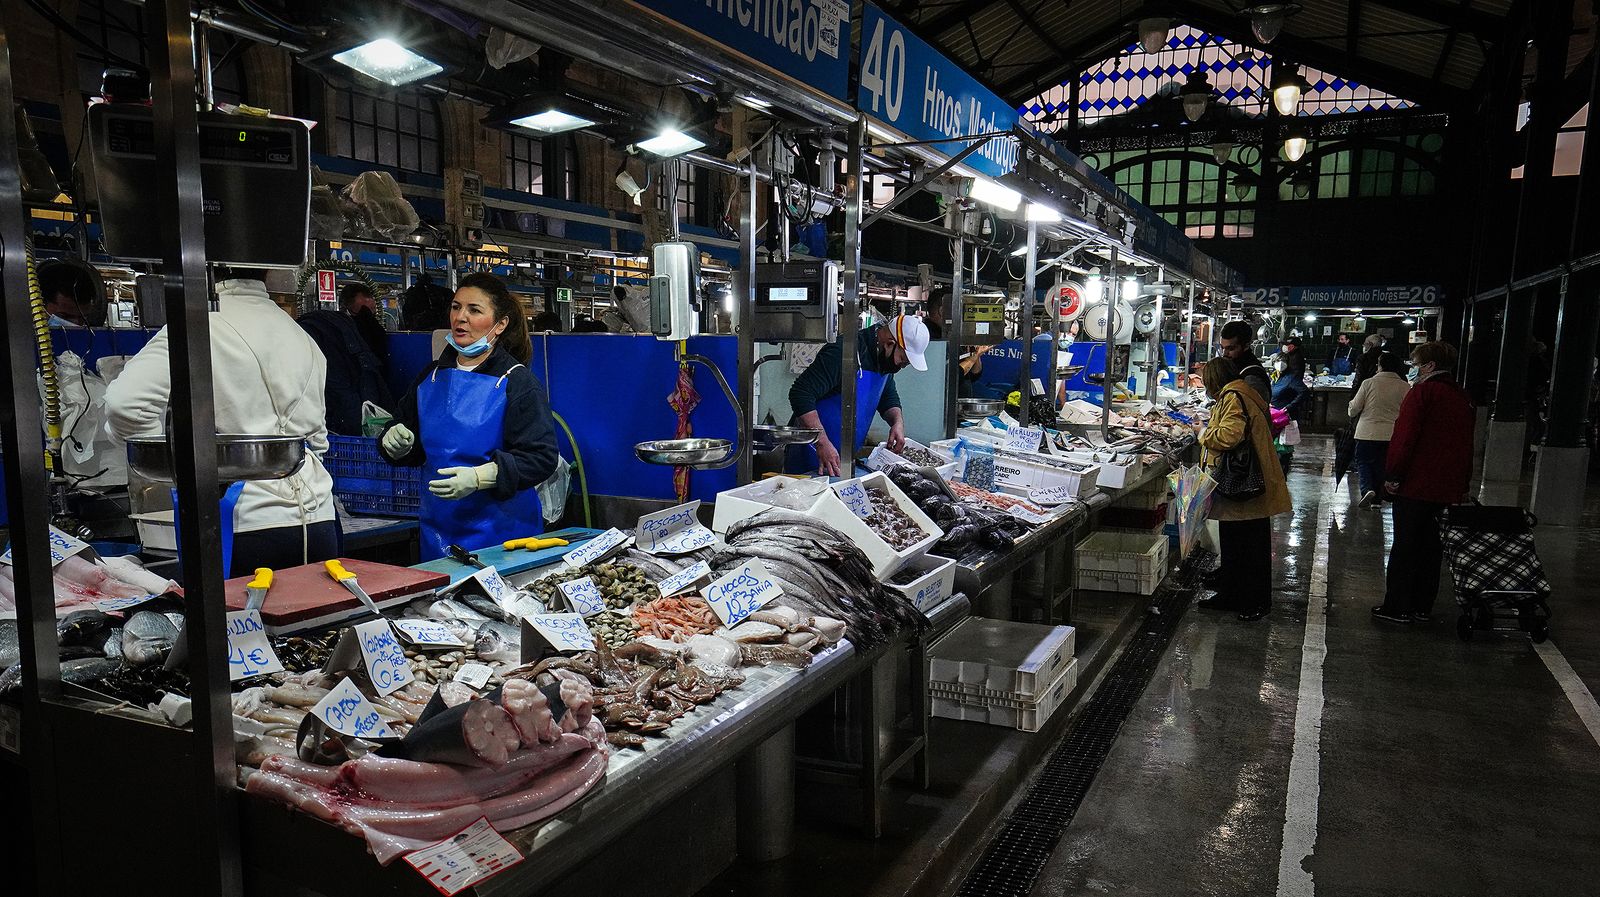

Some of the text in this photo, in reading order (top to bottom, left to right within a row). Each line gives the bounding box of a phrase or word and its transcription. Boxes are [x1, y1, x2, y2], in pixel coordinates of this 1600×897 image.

[861, 17, 906, 122] 40
[238, 131, 247, 142] 0
[1255, 287, 1280, 305] 25
[1301, 285, 1436, 304] Alonso y Antonio Flores 26
[984, 347, 1005, 358] RES
[993, 465, 1021, 476] RREIRO
[708, 567, 759, 603] CHOCOS
